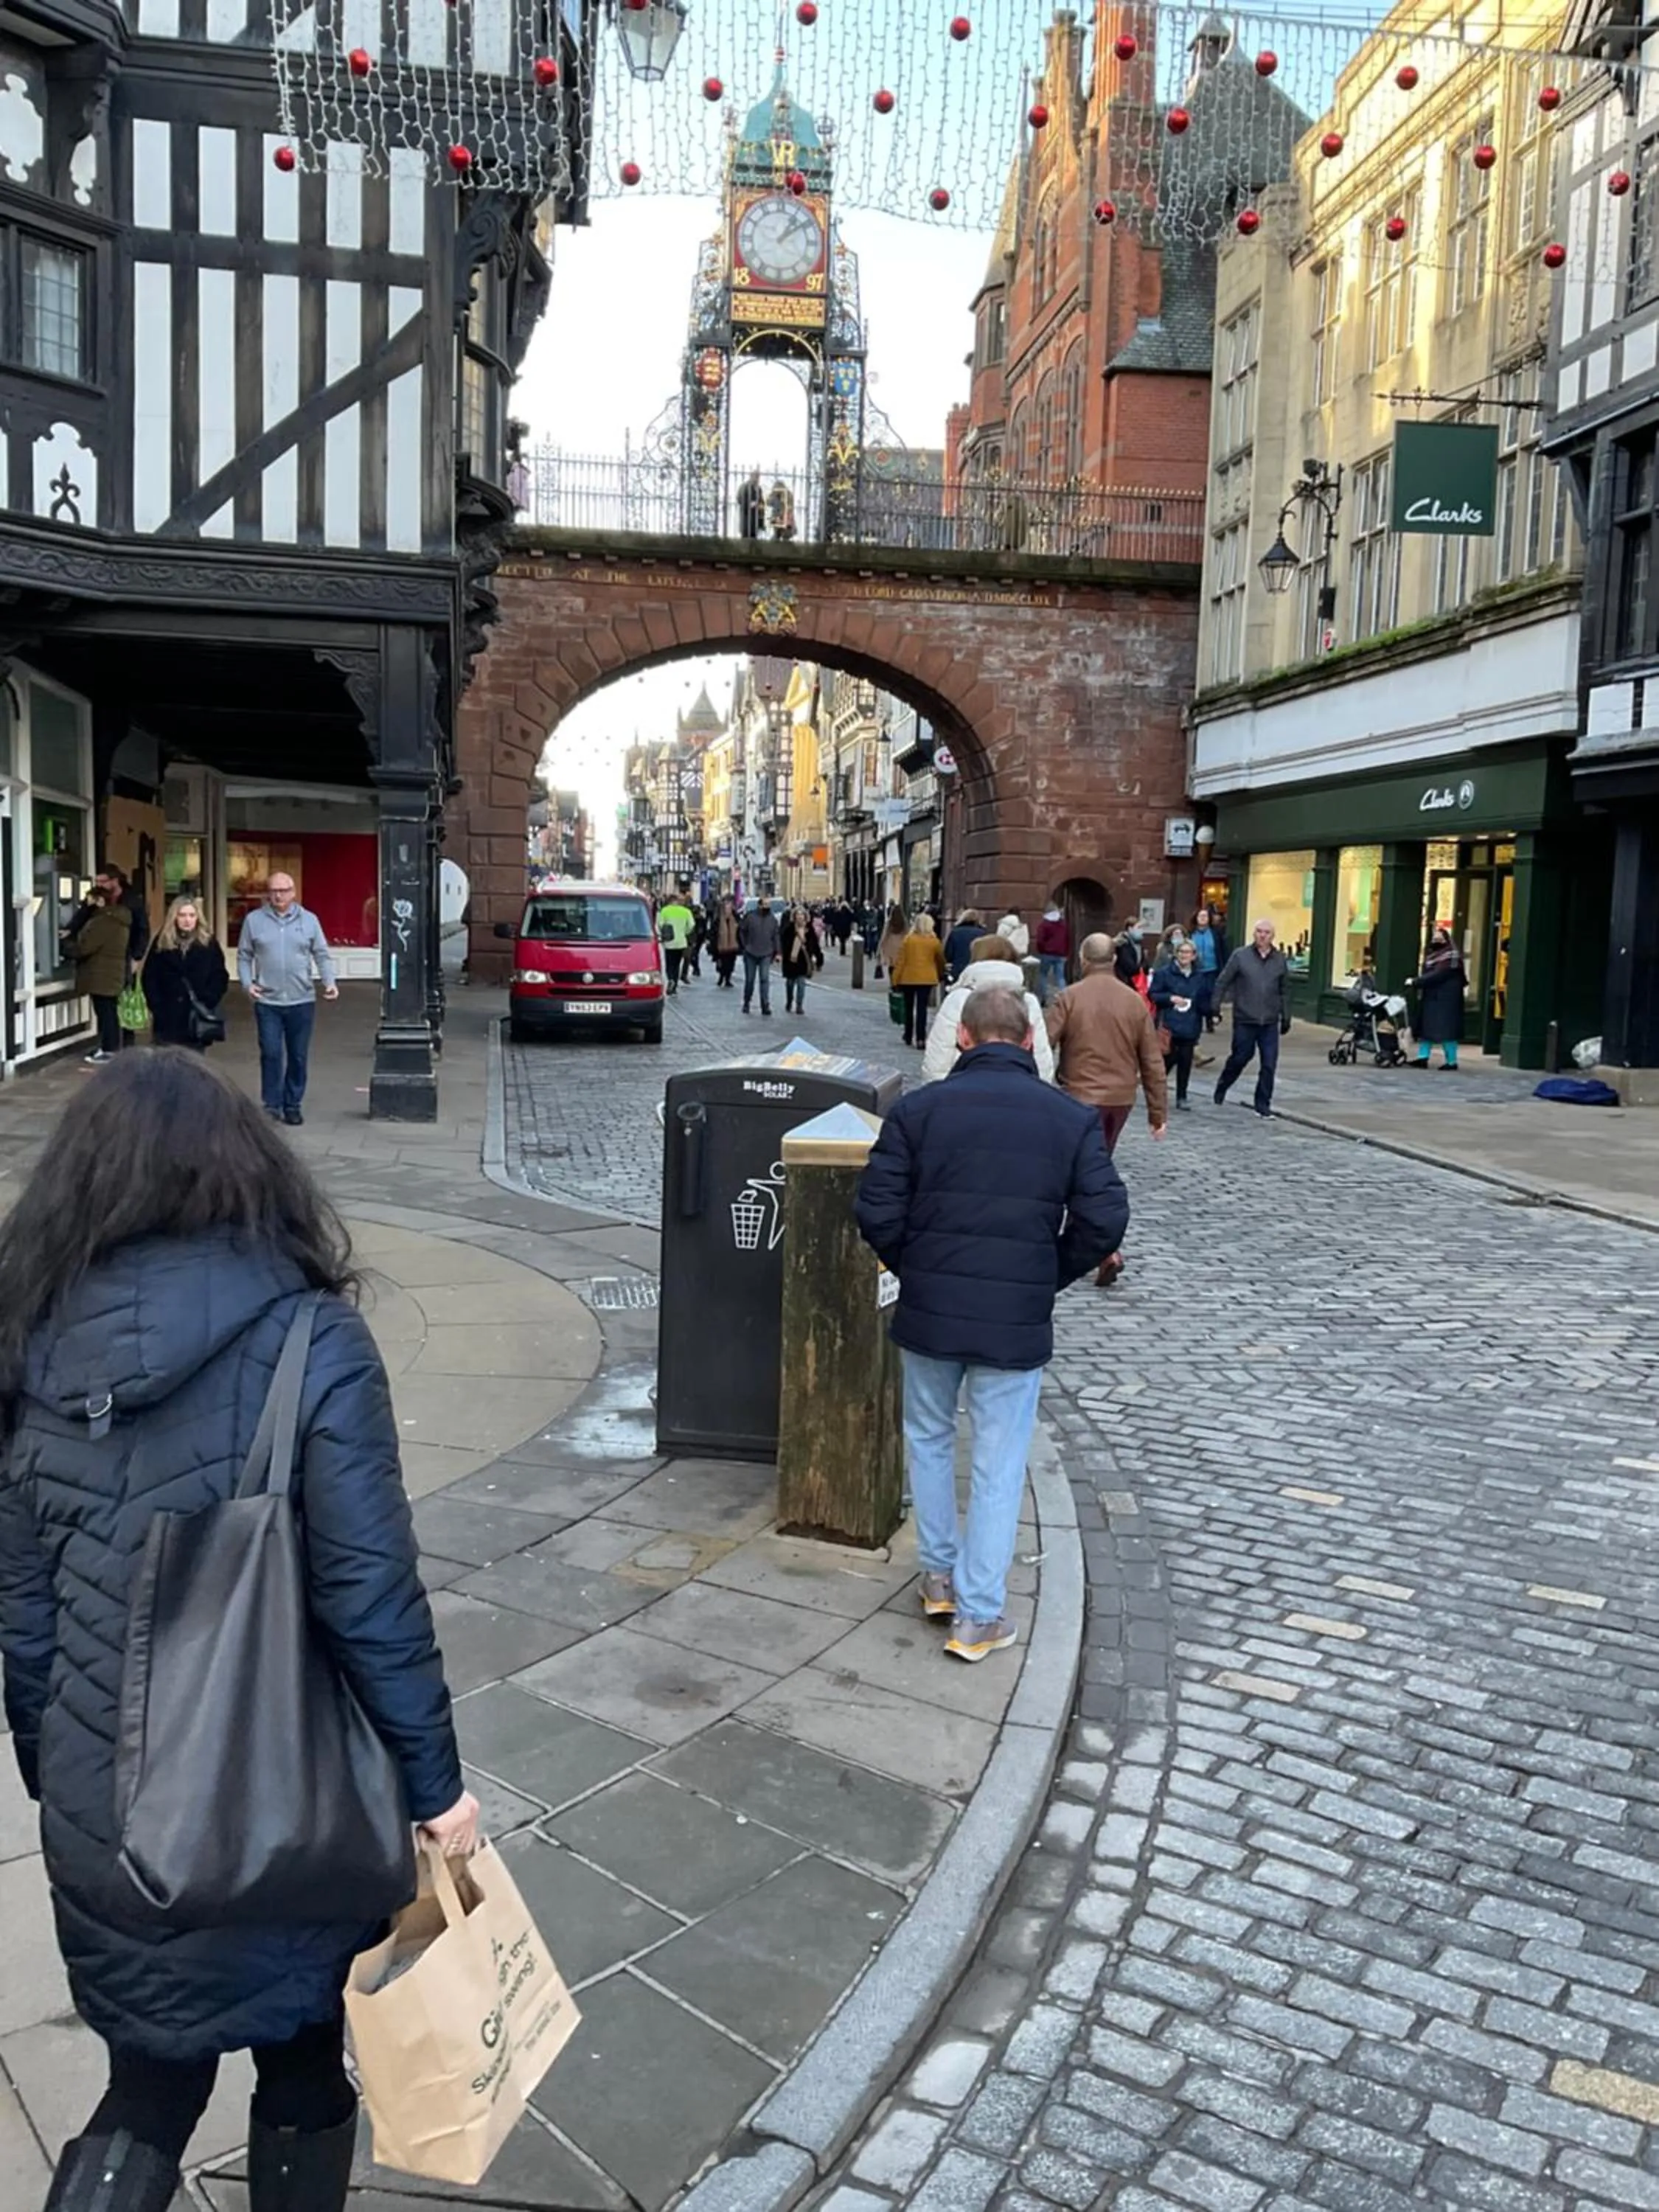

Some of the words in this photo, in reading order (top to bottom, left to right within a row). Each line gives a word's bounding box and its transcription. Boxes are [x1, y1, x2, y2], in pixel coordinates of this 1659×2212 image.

[733, 268, 750, 286] 18
[805, 274, 824, 291] 97
[1404, 497, 1483, 524] Clarks
[1419, 787, 1455, 811] Clarks
[742, 1080, 796, 1094] BigBelly
